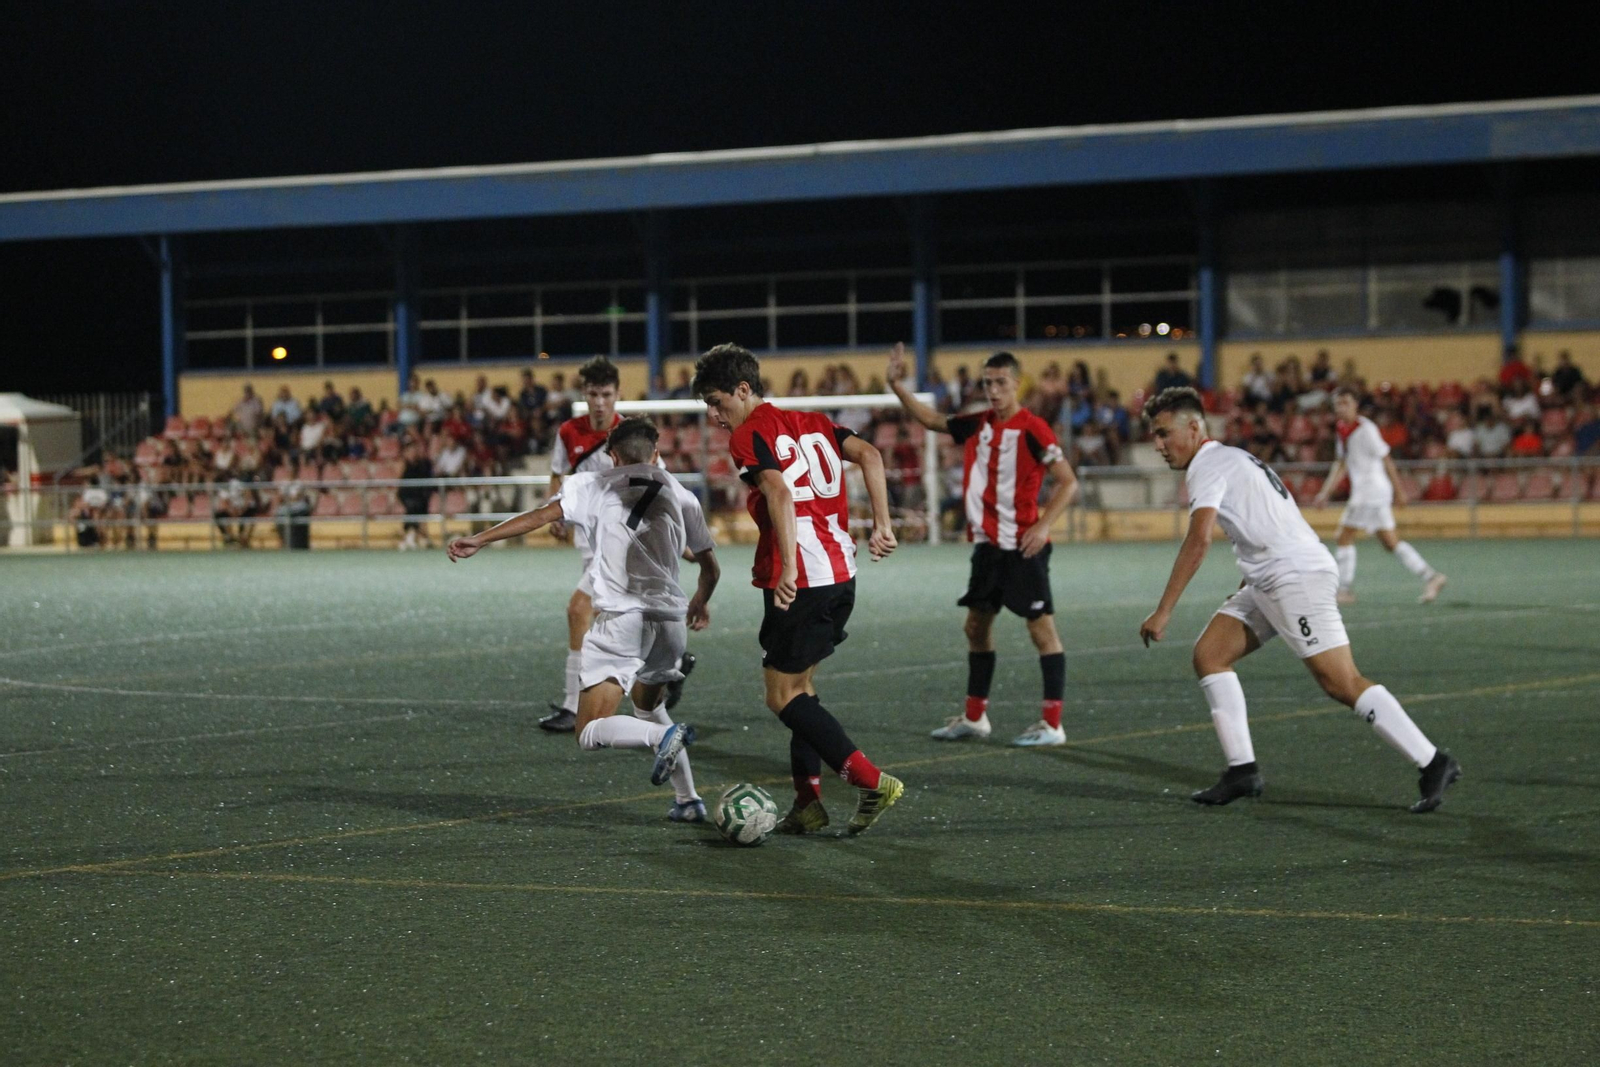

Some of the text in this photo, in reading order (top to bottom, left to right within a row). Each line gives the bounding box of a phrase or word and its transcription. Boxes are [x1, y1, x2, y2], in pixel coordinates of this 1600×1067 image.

[775, 432, 843, 502] 20
[626, 477, 664, 531] 7
[1298, 616, 1311, 637] 8
